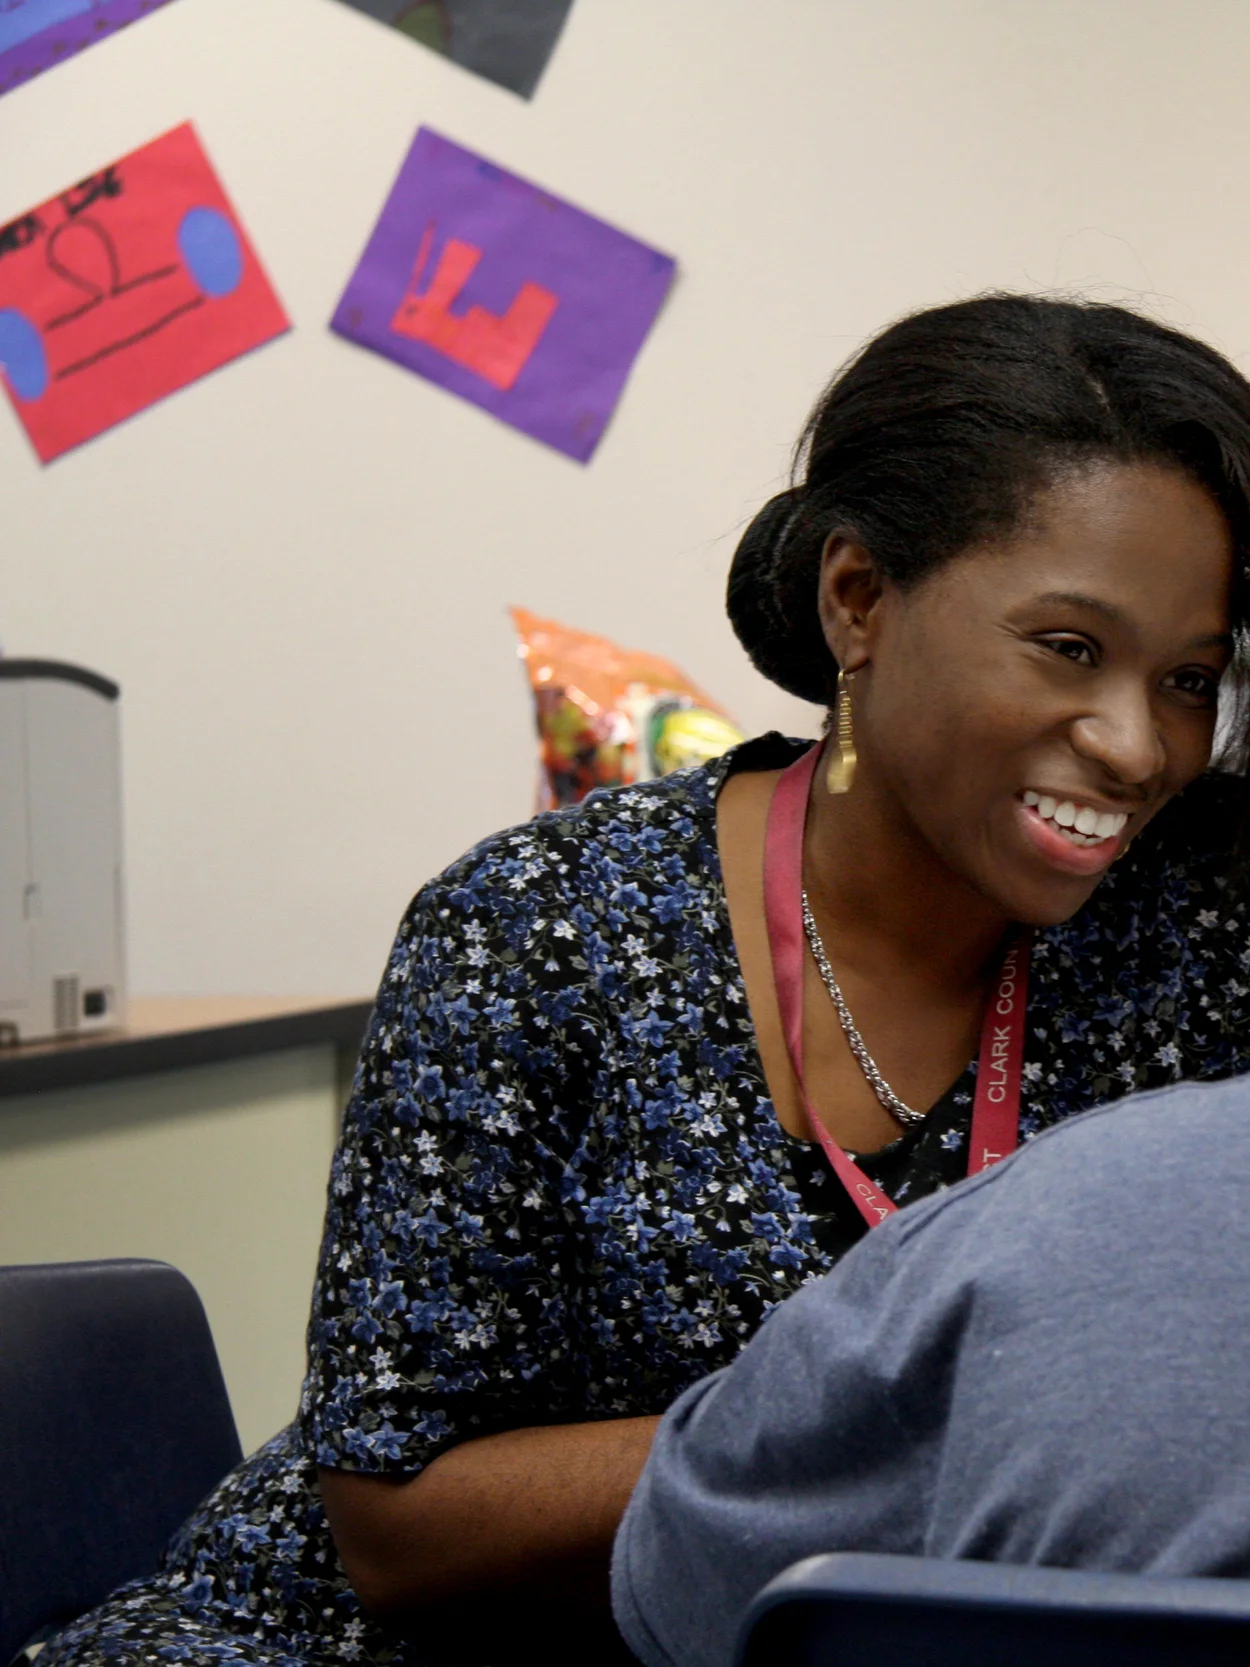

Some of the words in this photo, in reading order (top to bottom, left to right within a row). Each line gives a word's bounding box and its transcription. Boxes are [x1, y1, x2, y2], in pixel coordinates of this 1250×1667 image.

[996, 943, 1021, 1015] COUN
[987, 1025, 1012, 1103] CLARK
[856, 1183, 889, 1220] CLA
